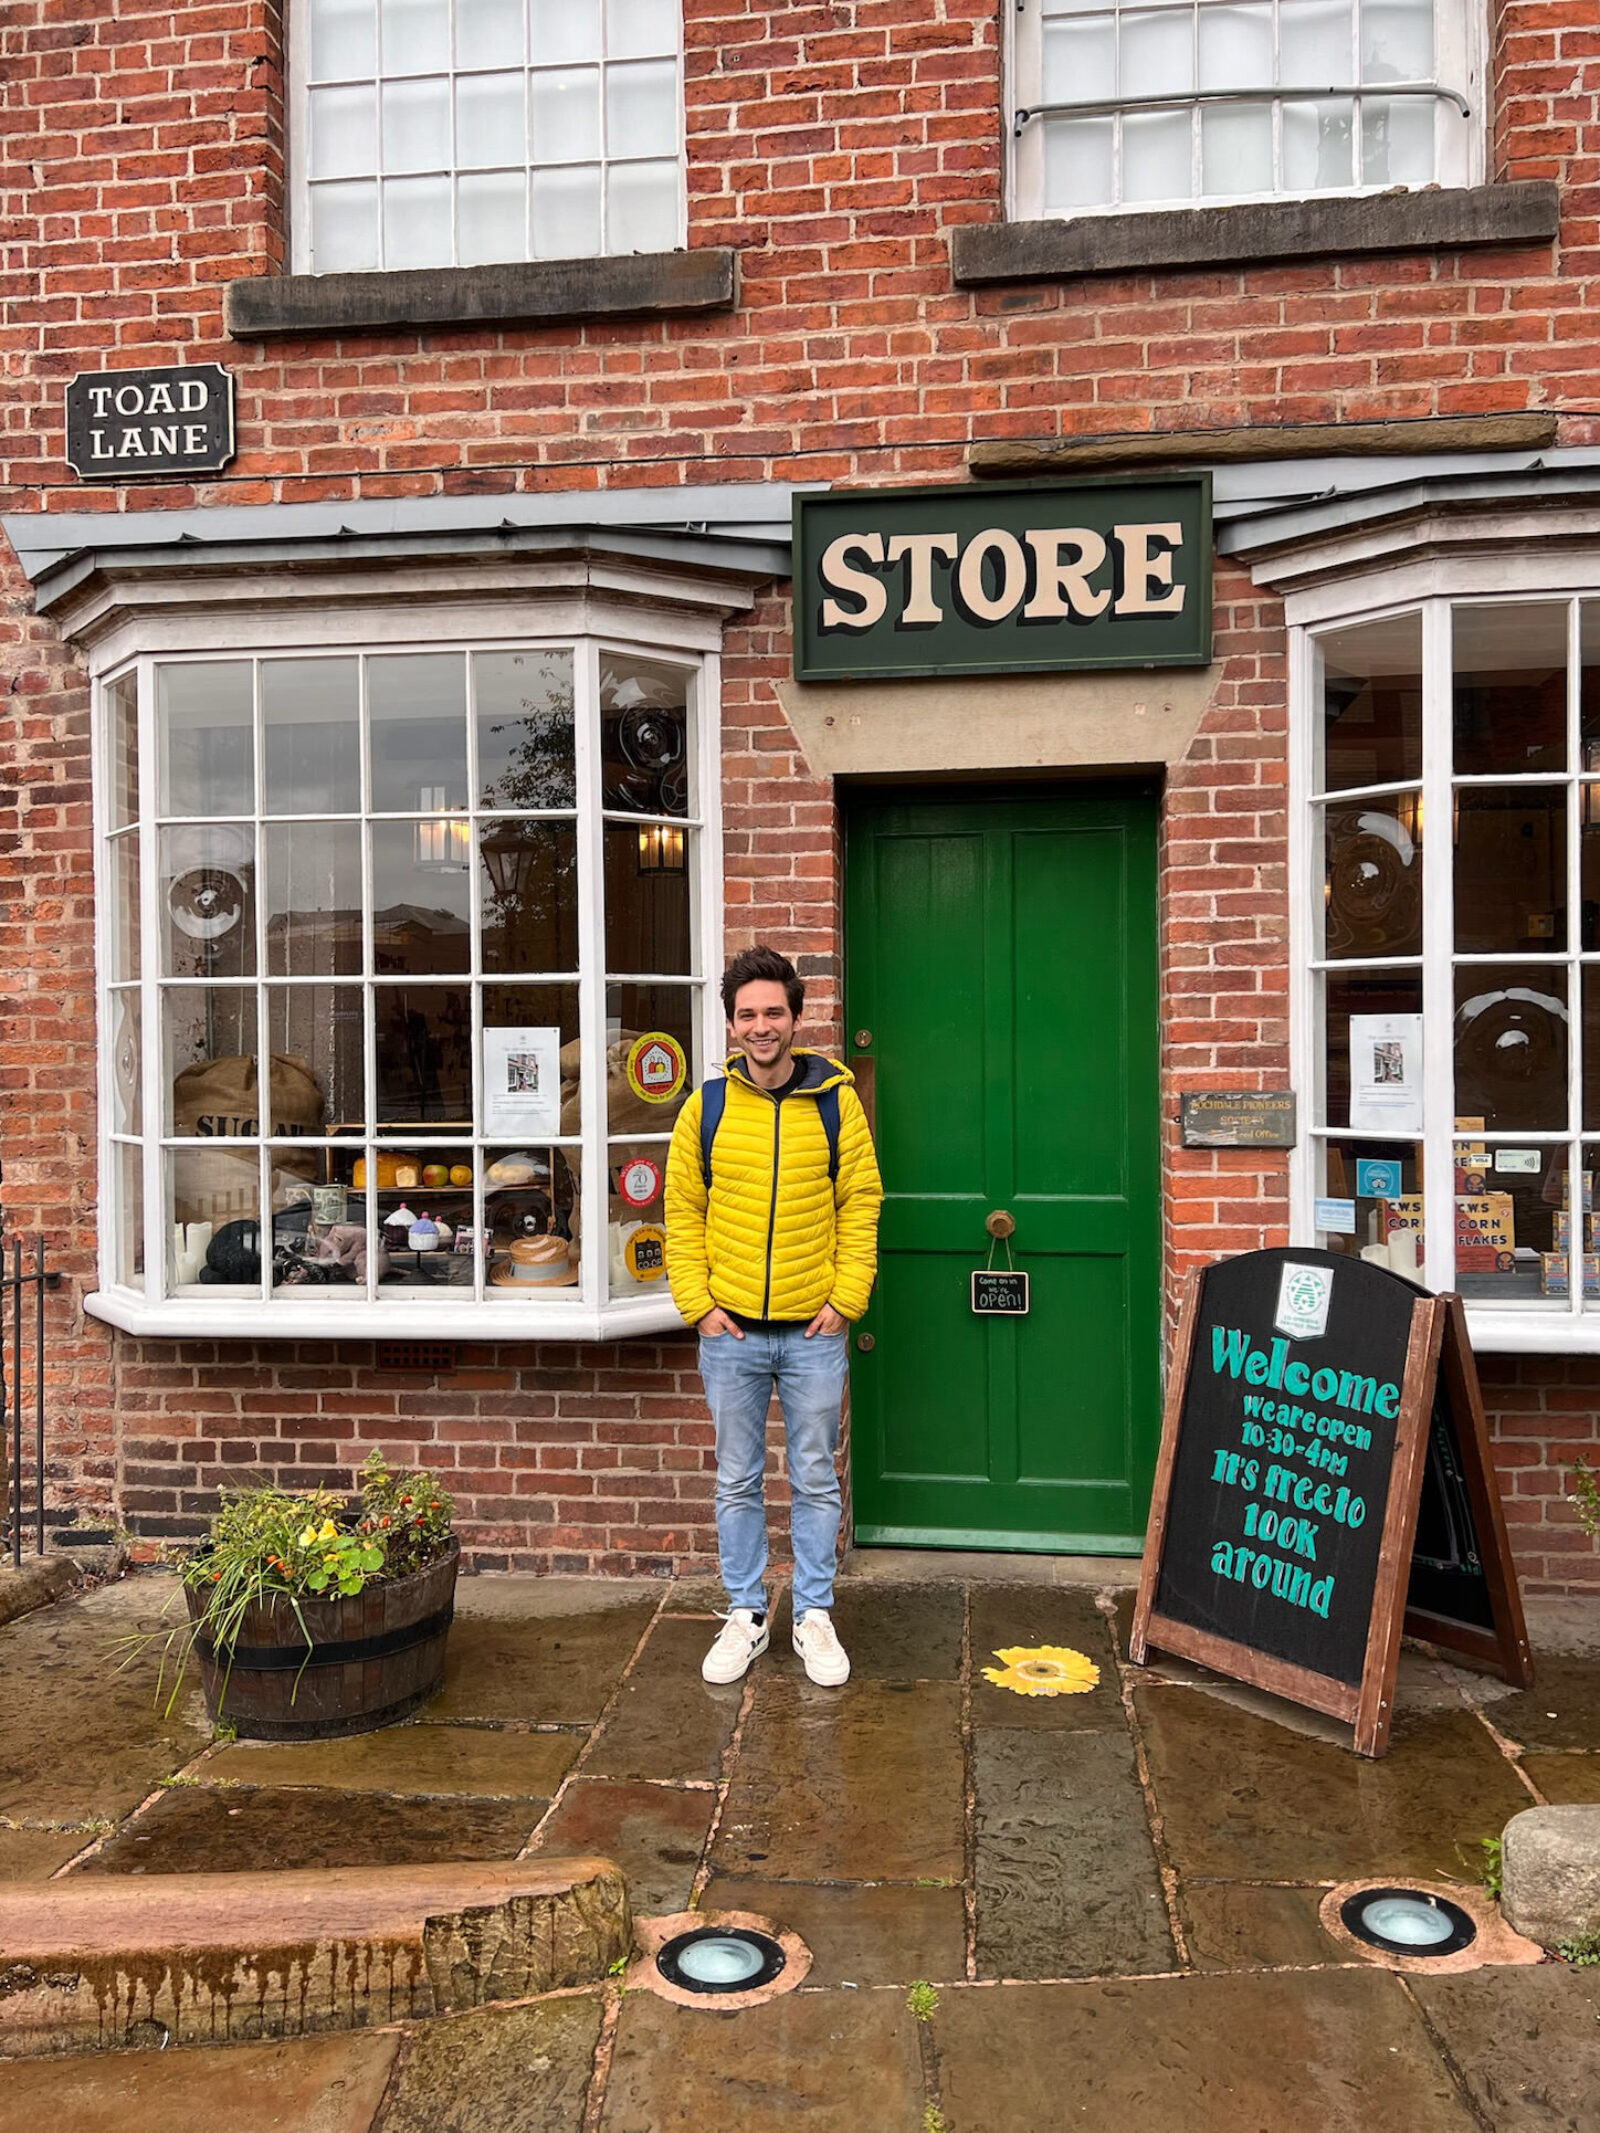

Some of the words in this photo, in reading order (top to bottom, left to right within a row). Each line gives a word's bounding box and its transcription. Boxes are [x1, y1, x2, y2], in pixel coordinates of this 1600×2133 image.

[88, 380, 209, 418] TOAD
[89, 424, 209, 459] LANE
[819, 521, 1186, 630] STORE
[1242, 1100, 1292, 1111] PIONEERS
[632, 1173, 648, 1187] 70
[1389, 1218, 1425, 1229] COR
[1458, 1219, 1501, 1230] CORN
[1458, 1235, 1508, 1246] FLAKES
[1211, 1324, 1400, 1419] Welcome
[1275, 1403, 1316, 1433] are
[1316, 1416, 1373, 1451] open
[1263, 1464, 1334, 1516] free
[1333, 1485, 1367, 1529] to
[1210, 1540, 1336, 1620] around
